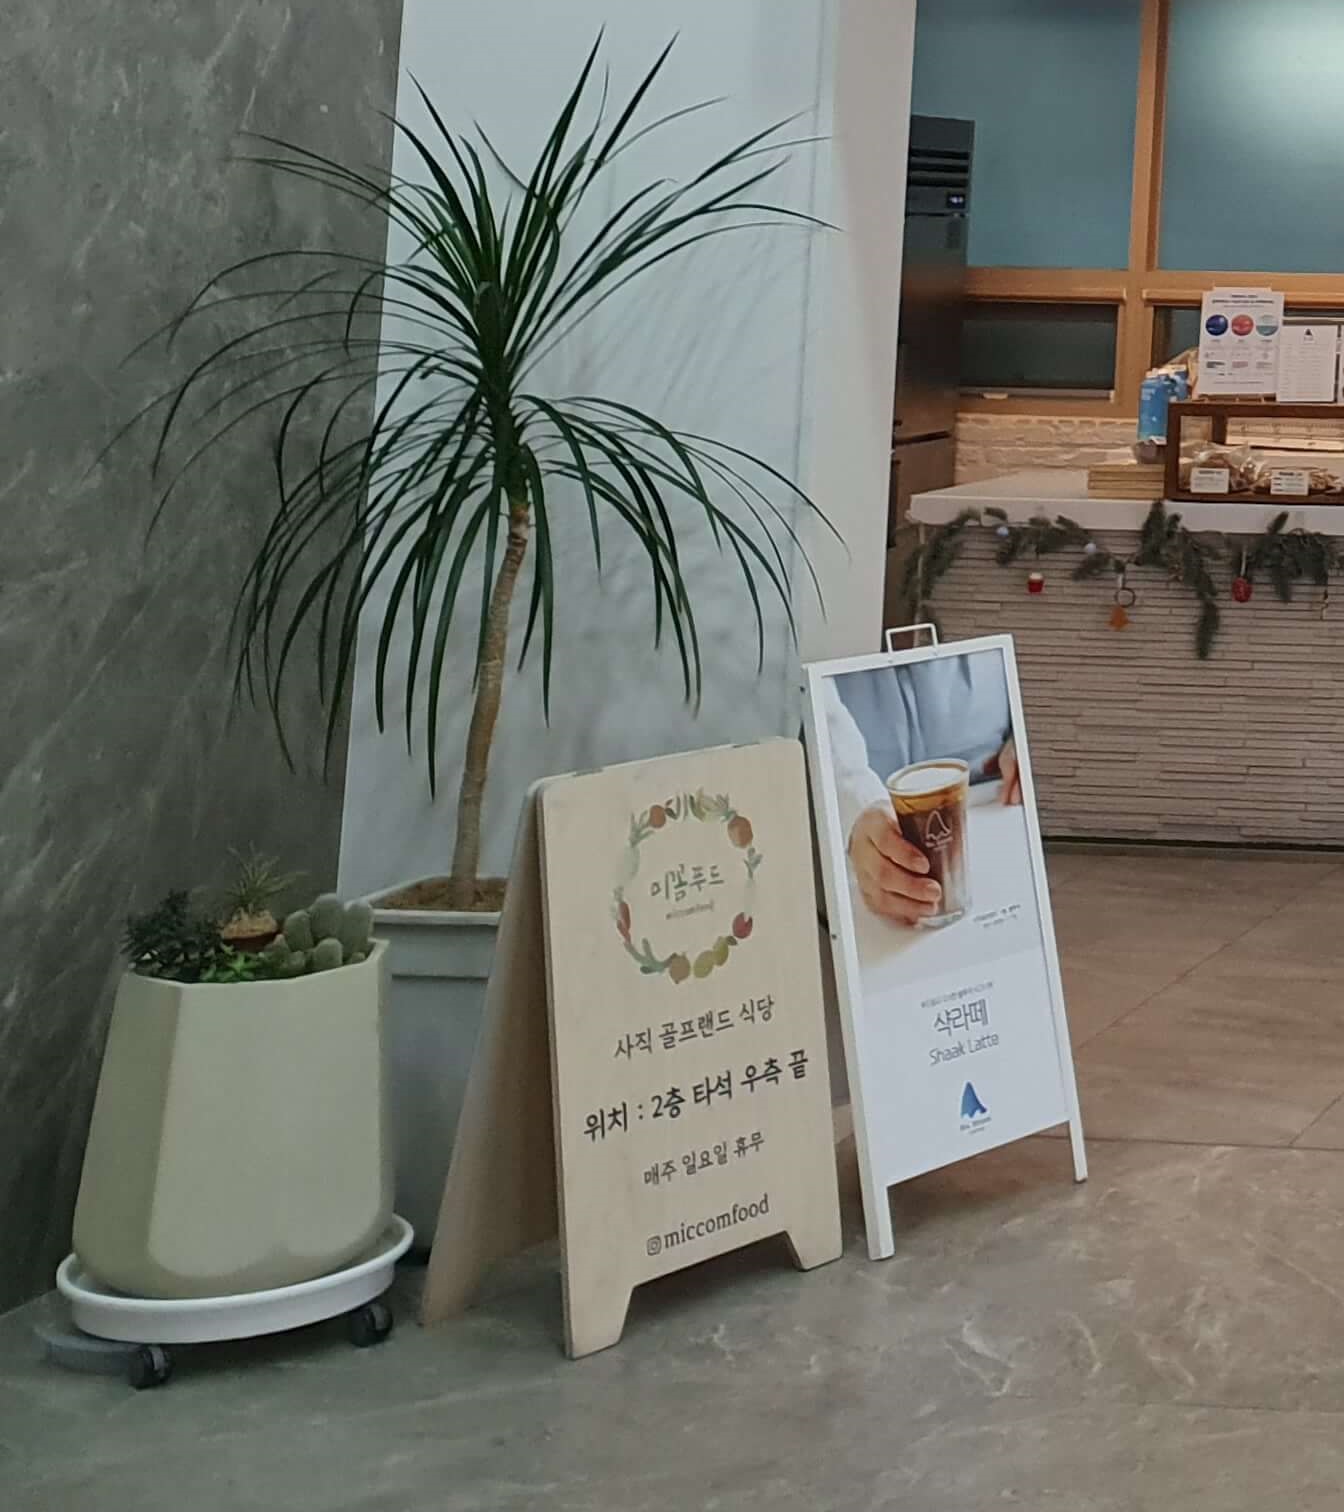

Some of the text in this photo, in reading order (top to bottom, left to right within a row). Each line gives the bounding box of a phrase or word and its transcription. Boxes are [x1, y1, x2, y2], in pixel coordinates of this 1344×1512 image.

[614, 994, 775, 1060] 사직 골프랜드 식당
[934, 999, 989, 1036] 샥라떼
[929, 1033, 999, 1067] Shaak Latte
[583, 1101, 628, 1142] 위치
[651, 1086, 686, 1119] 2층
[692, 1070, 733, 1106] 타석
[740, 1057, 782, 1092] 우측
[787, 1048, 809, 1080] 끝
[643, 1131, 765, 1185] 매주 일요일 휴무
